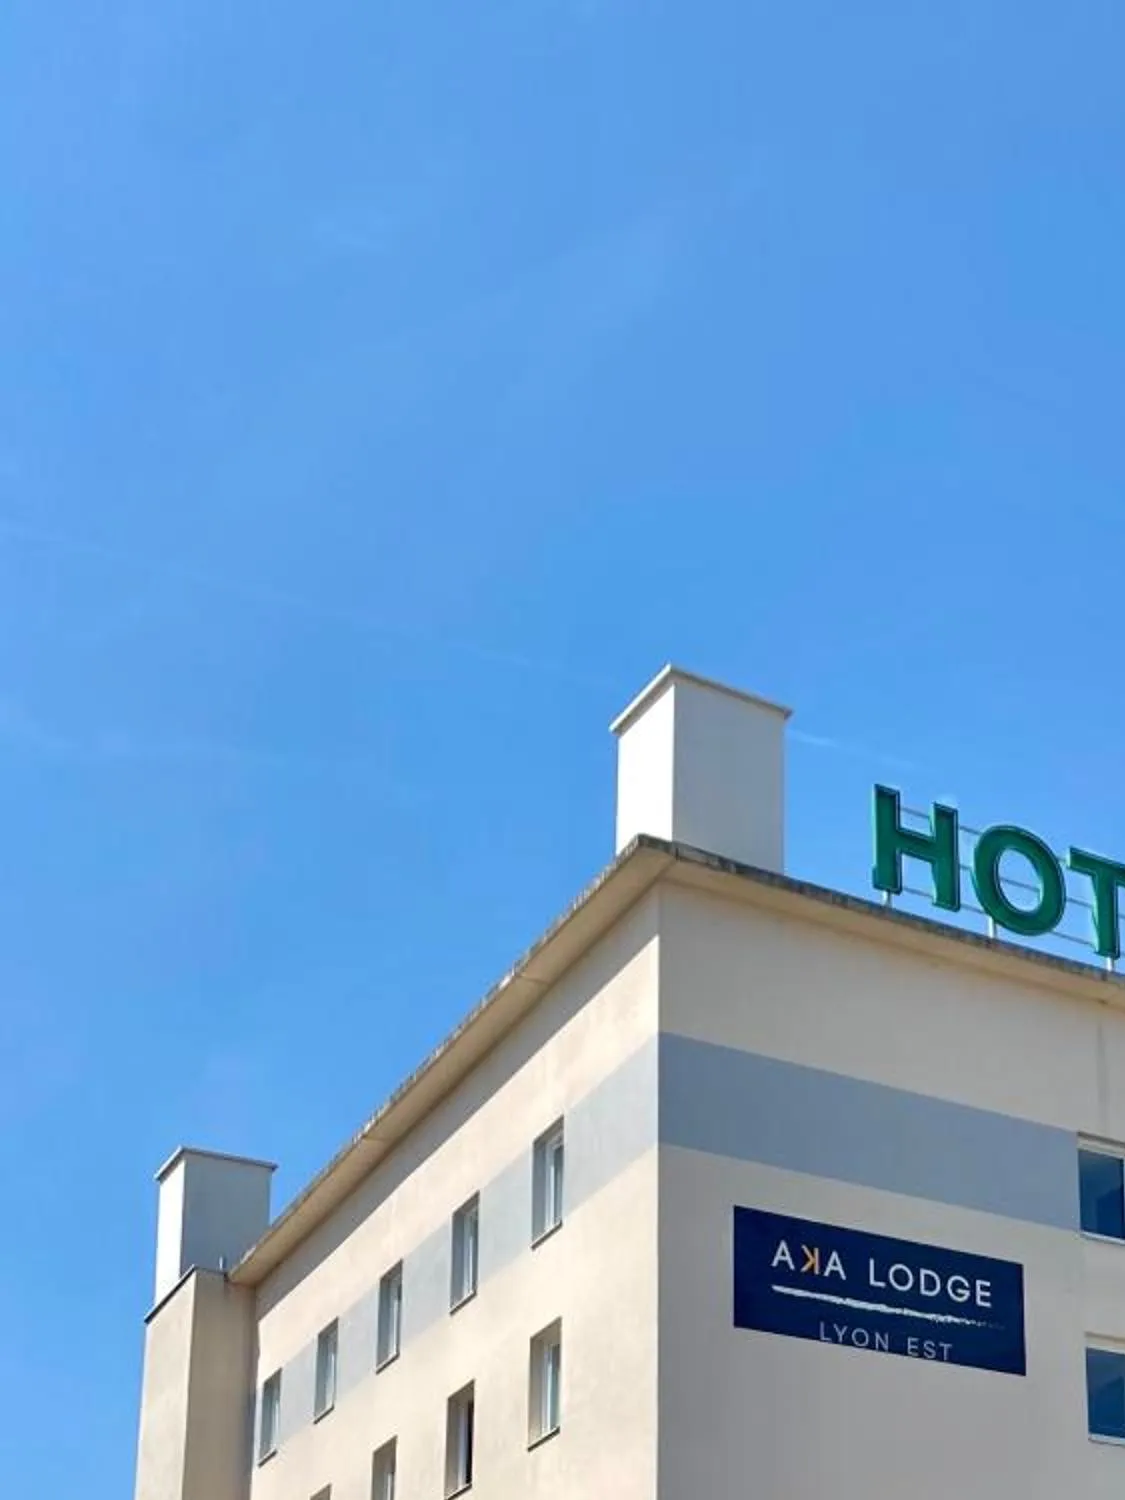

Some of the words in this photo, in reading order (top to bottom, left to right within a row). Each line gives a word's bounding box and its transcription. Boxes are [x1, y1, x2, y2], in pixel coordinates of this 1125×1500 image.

[771, 1239, 847, 1281] AKA
[869, 1258, 992, 1308] LODGE
[819, 1321, 890, 1352] LYON
[907, 1337, 953, 1361] EST
